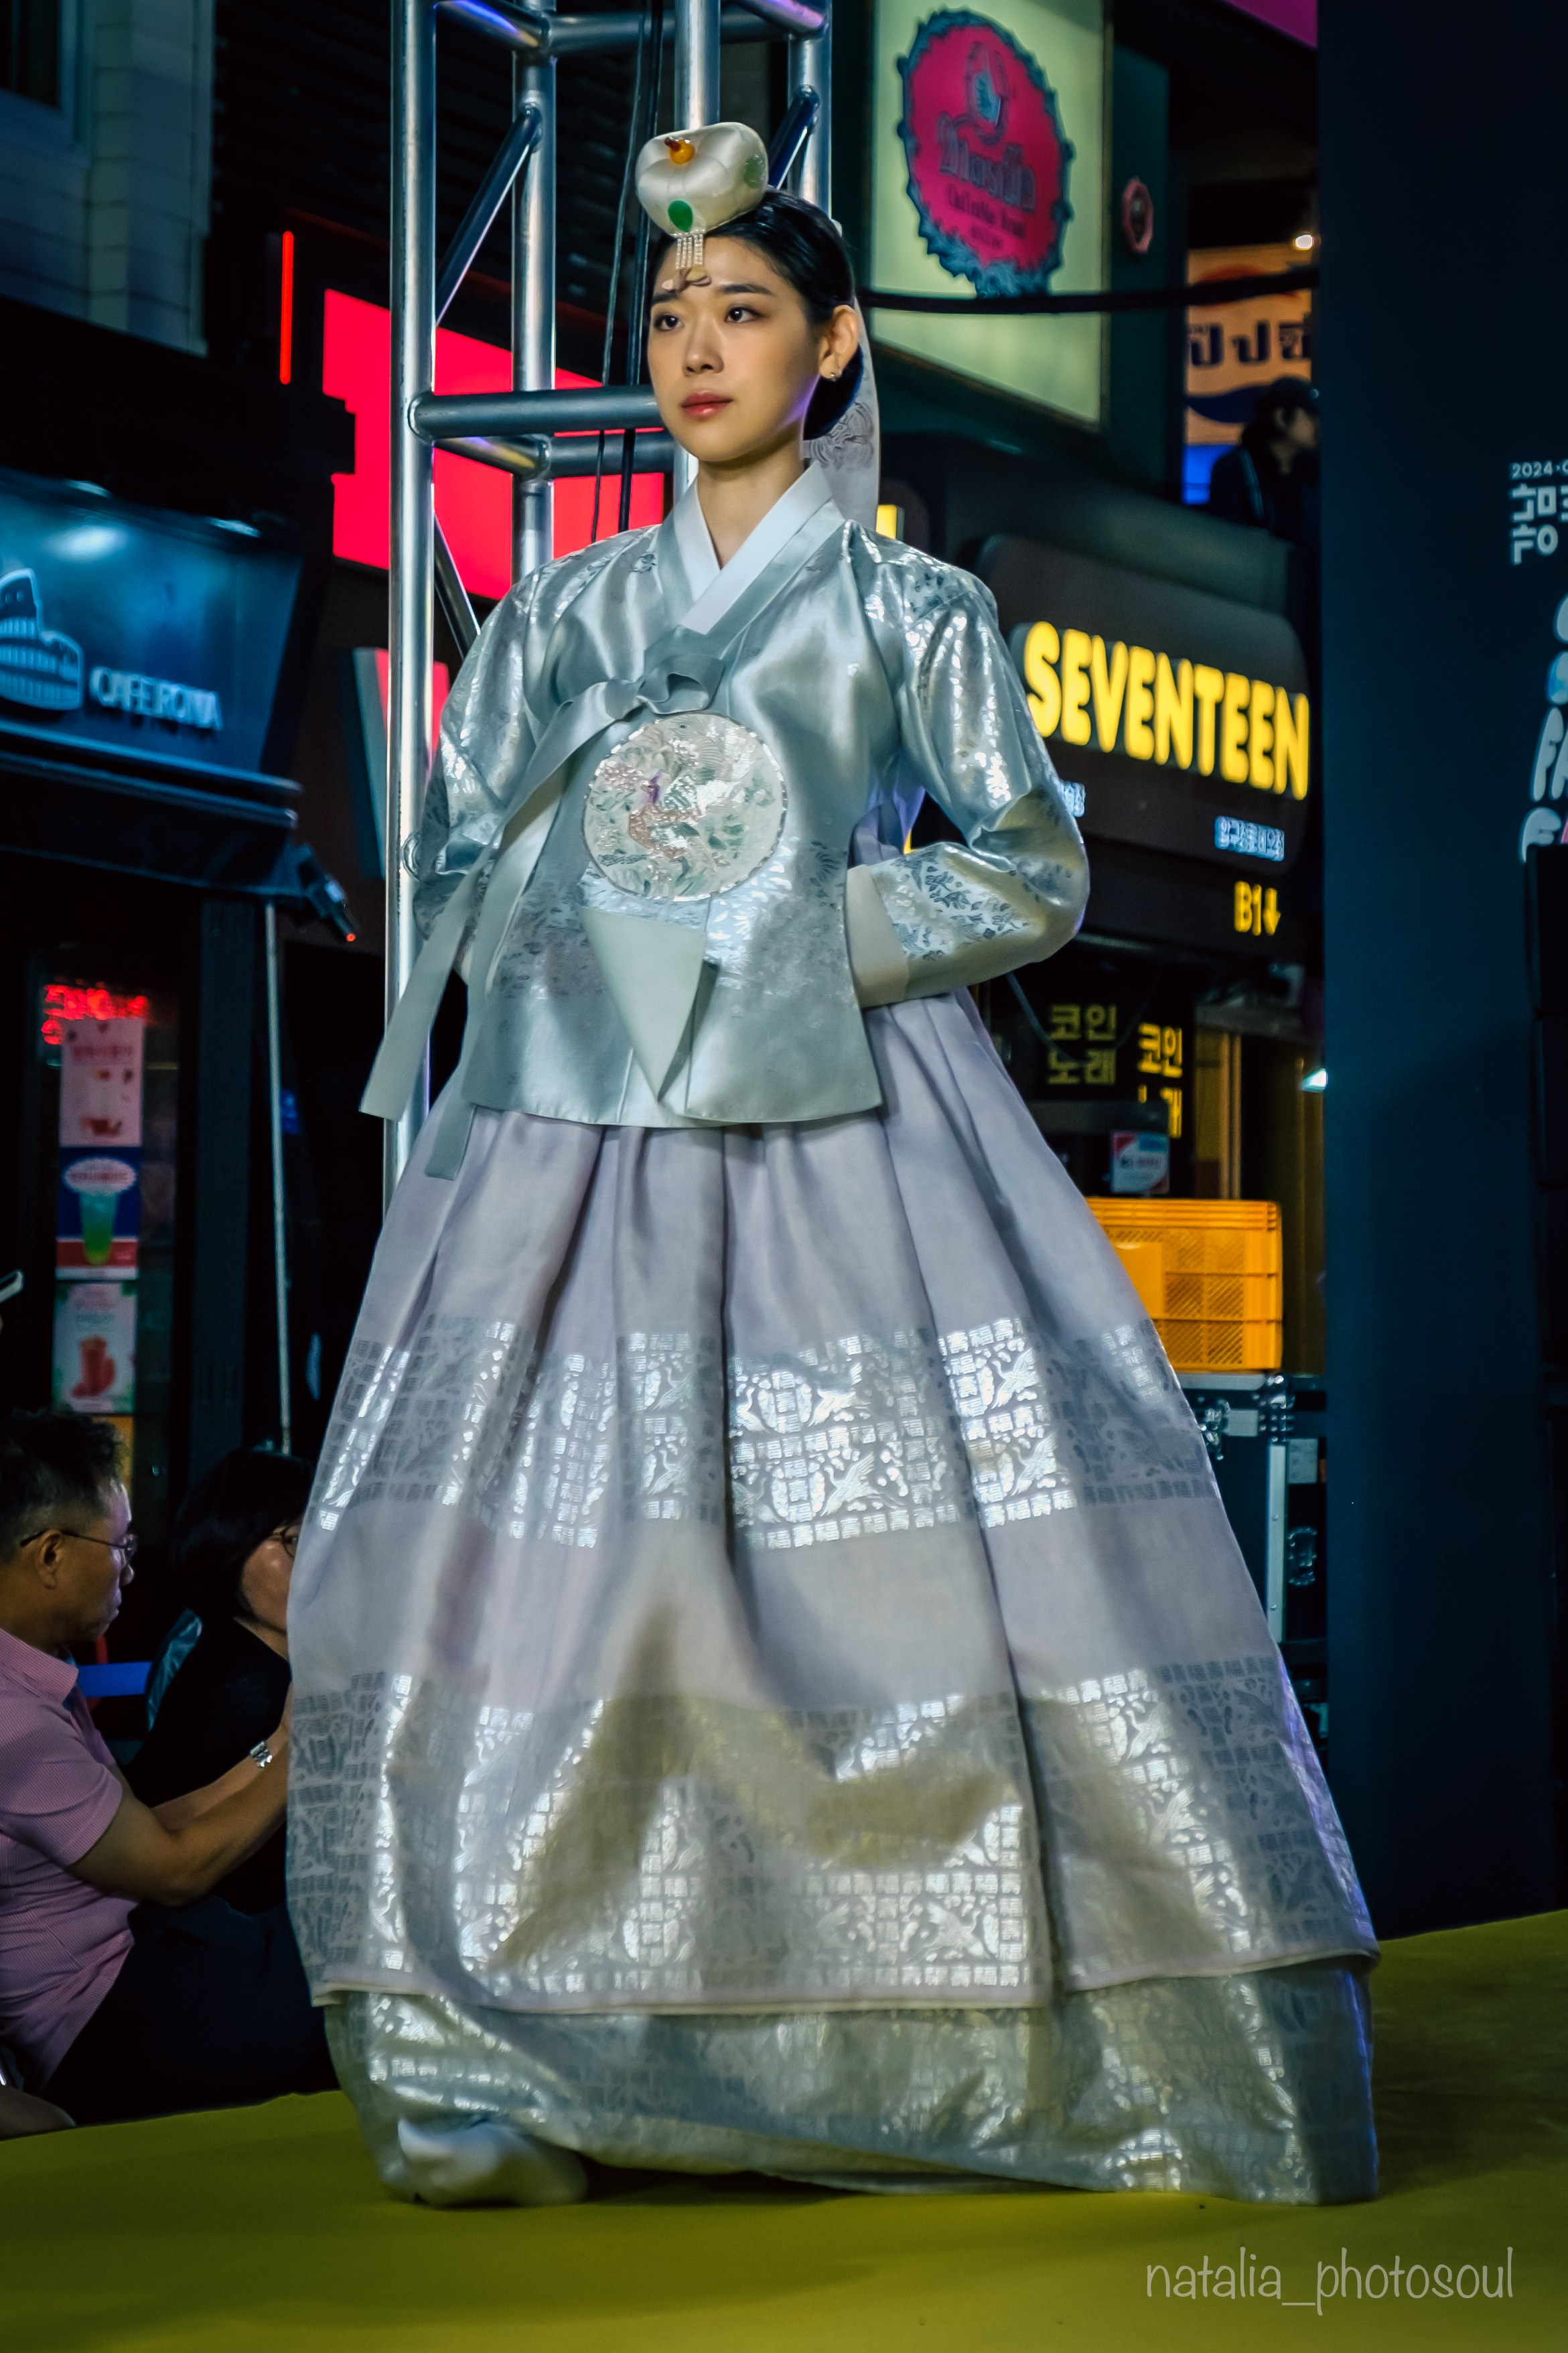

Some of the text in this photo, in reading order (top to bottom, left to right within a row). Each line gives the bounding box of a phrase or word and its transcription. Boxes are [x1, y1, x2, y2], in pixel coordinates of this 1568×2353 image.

[1024, 620, 1309, 801] SEVENTEEN
[1050, 1004, 1117, 1041] 코인
[1138, 1022, 1183, 1079] 코인
